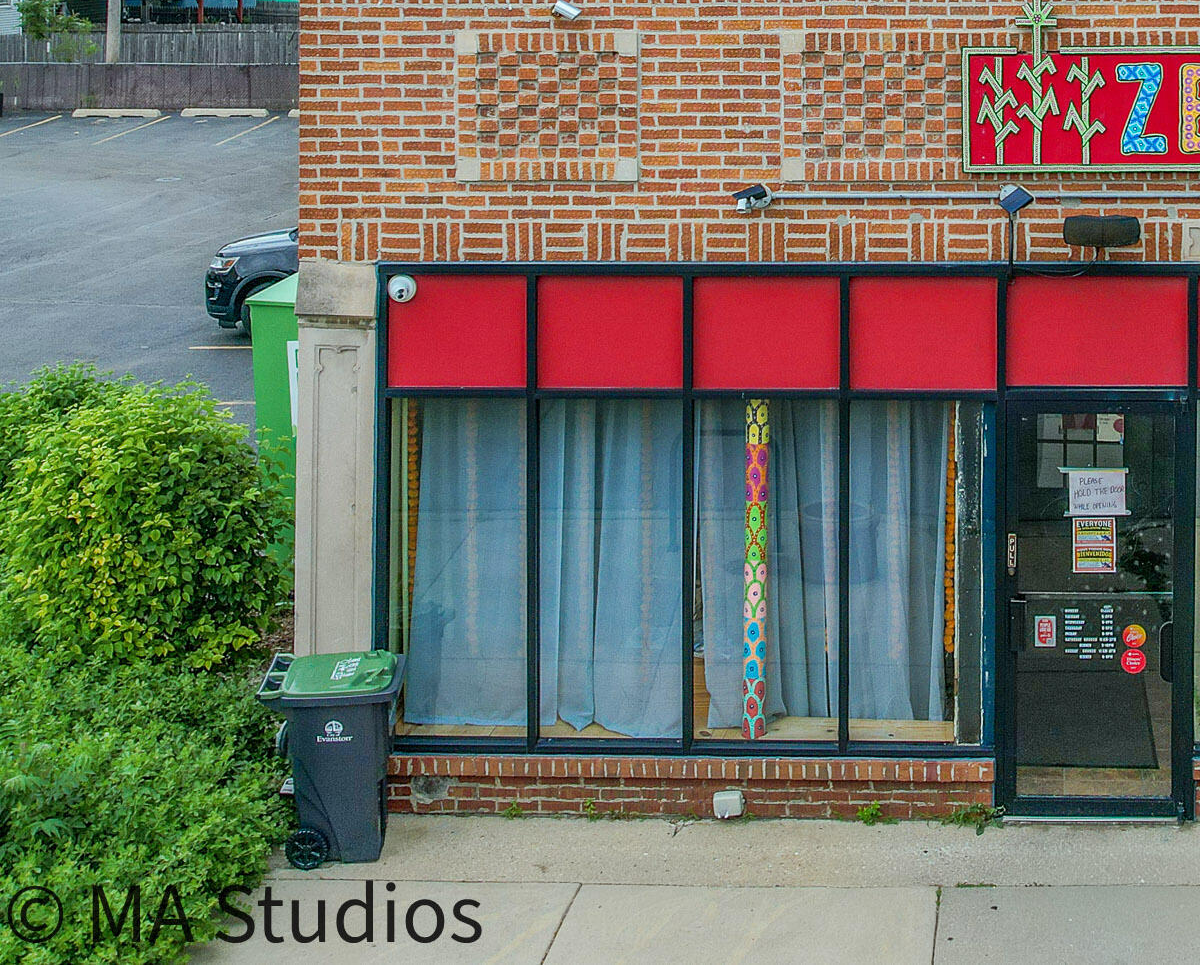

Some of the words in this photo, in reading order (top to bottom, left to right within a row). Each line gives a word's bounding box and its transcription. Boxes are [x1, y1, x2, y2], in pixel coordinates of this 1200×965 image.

[1079, 477, 1103, 486] PLEASE
[1073, 488, 1092, 499] HOLD
[1095, 487, 1108, 495] THE
[1076, 520, 1112, 528] EVERYONE
